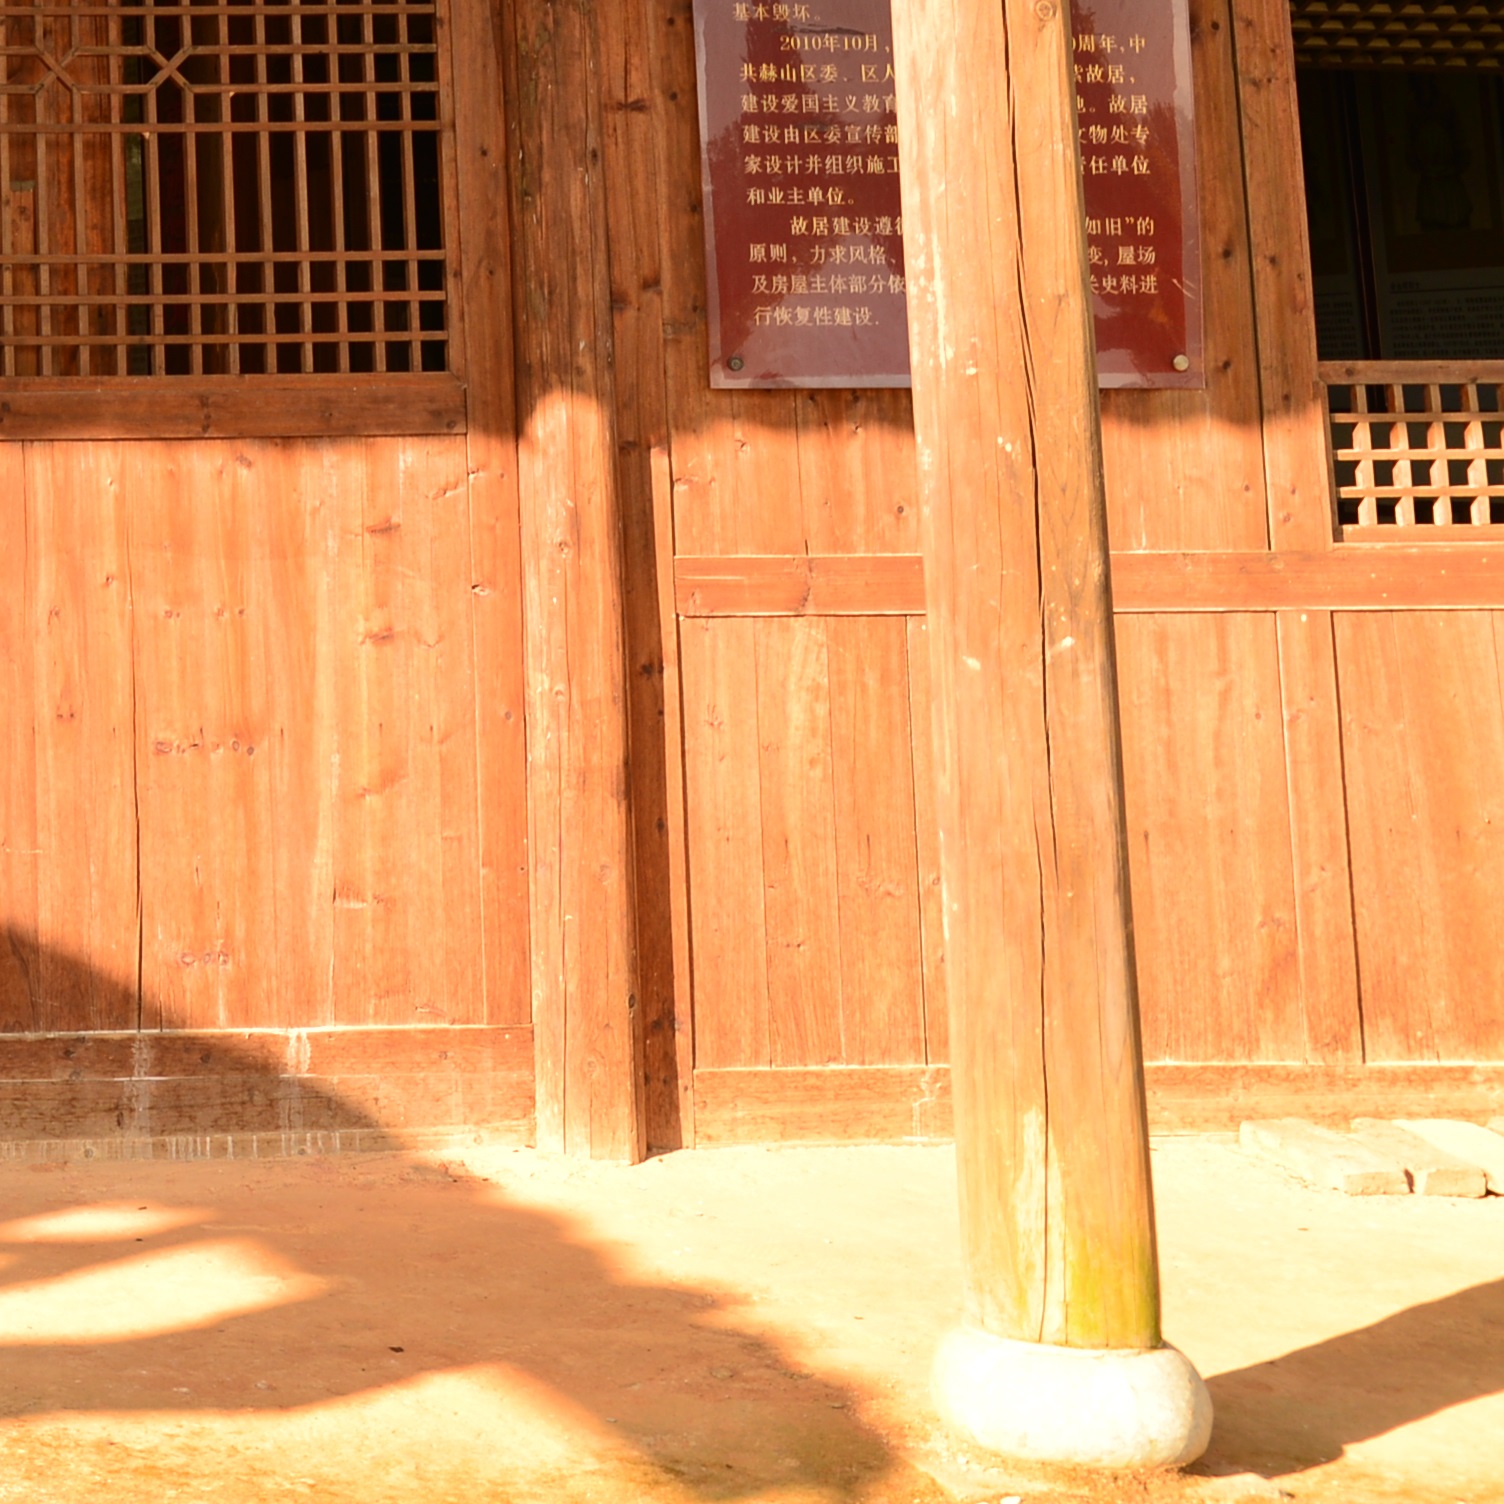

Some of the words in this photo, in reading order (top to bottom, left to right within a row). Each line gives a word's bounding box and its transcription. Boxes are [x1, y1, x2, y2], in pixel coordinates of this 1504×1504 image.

[732, 3, 821, 23] 基本毁坏。
[740, 63, 897, 83] 共赫山区委、区人
[741, 93, 897, 114] 建设爱国主义教育
[743, 124, 899, 145] 建设由区委宣传部
[744, 154, 900, 175] 家设计并组织施工
[746, 186, 856, 207] 和业主单位。
[751, 274, 906, 295] 及房屋主体部分依
